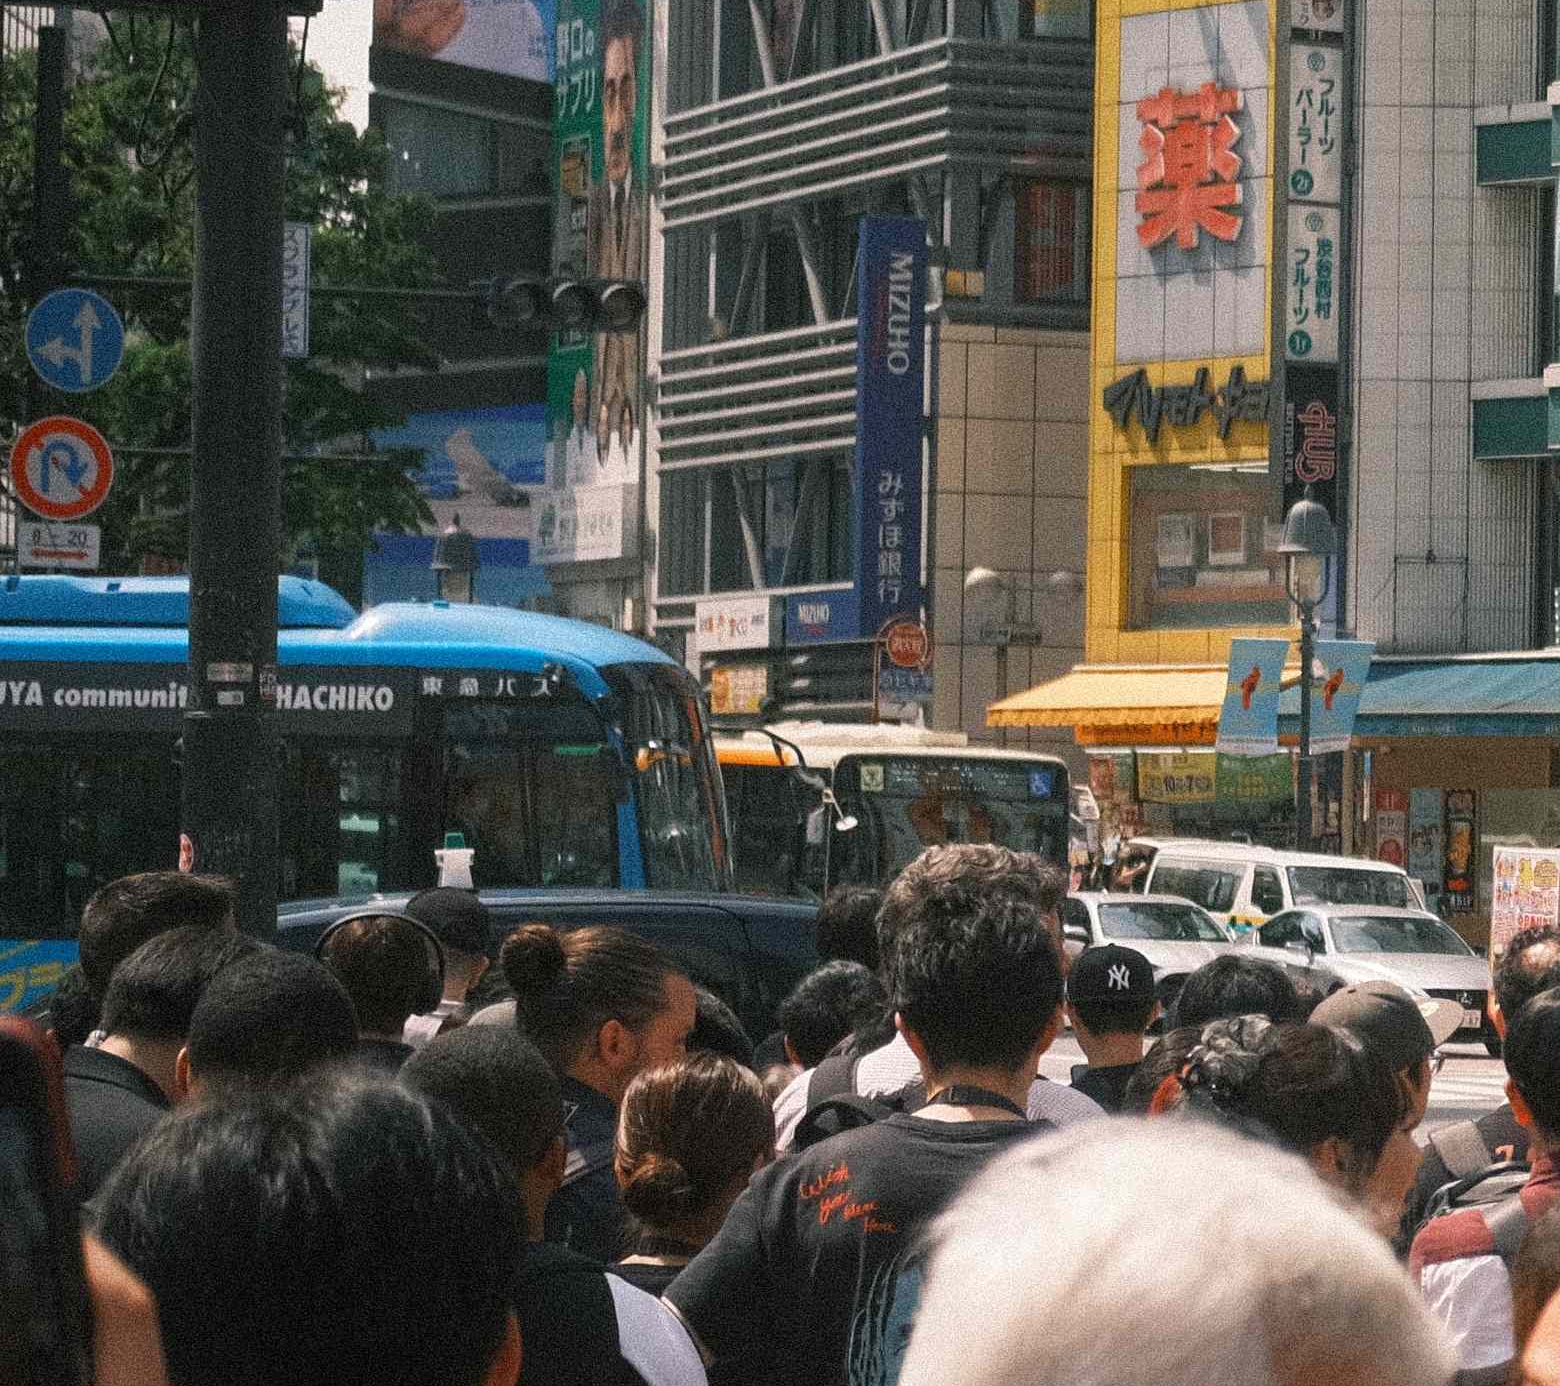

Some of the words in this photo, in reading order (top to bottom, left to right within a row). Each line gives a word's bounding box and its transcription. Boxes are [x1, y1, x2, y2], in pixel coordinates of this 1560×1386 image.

[1296, 88, 1313, 165] パーラー
[1317, 78, 1336, 155] フルーツ
[1136, 81, 1246, 251] 薬
[887, 252, 913, 374] MIZUHO
[1294, 248, 1310, 325] フルーツ
[1295, 400, 1336, 483] HUB
[879, 470, 902, 605] みずほ銀行
[276, 685, 394, 711] HACHIKO
[421, 675, 554, 698] 東急バス
[1108, 964, 1130, 990] NY
